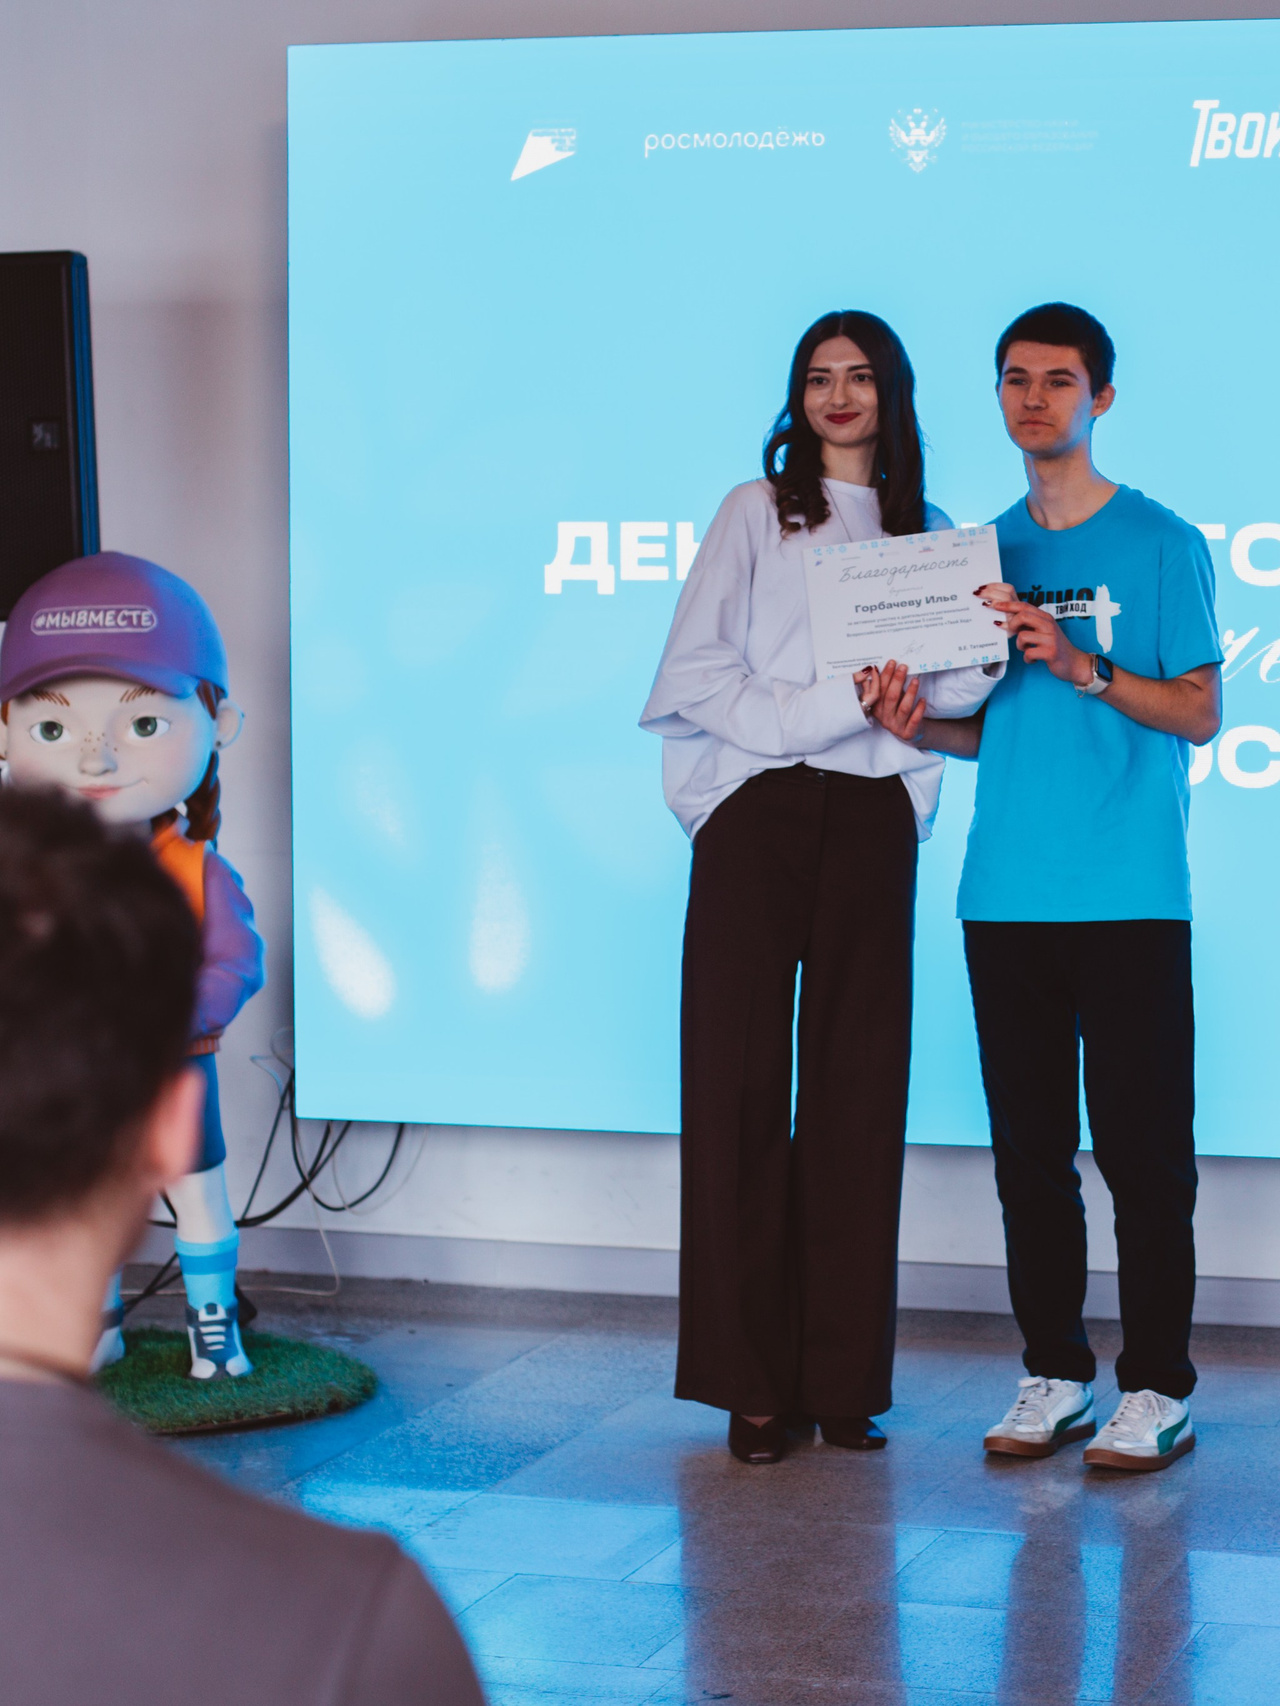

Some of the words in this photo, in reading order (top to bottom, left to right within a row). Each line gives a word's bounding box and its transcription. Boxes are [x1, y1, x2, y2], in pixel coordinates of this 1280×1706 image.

[644, 126, 826, 159] росмолодёжь
[838, 557, 969, 586] Благодарность
[855, 599, 922, 614] Горбачеву
[925, 594, 958, 604] Илье
[1069, 602, 1087, 613] ХОД
[34, 609, 151, 629] #МЫВМЕСТЕ
